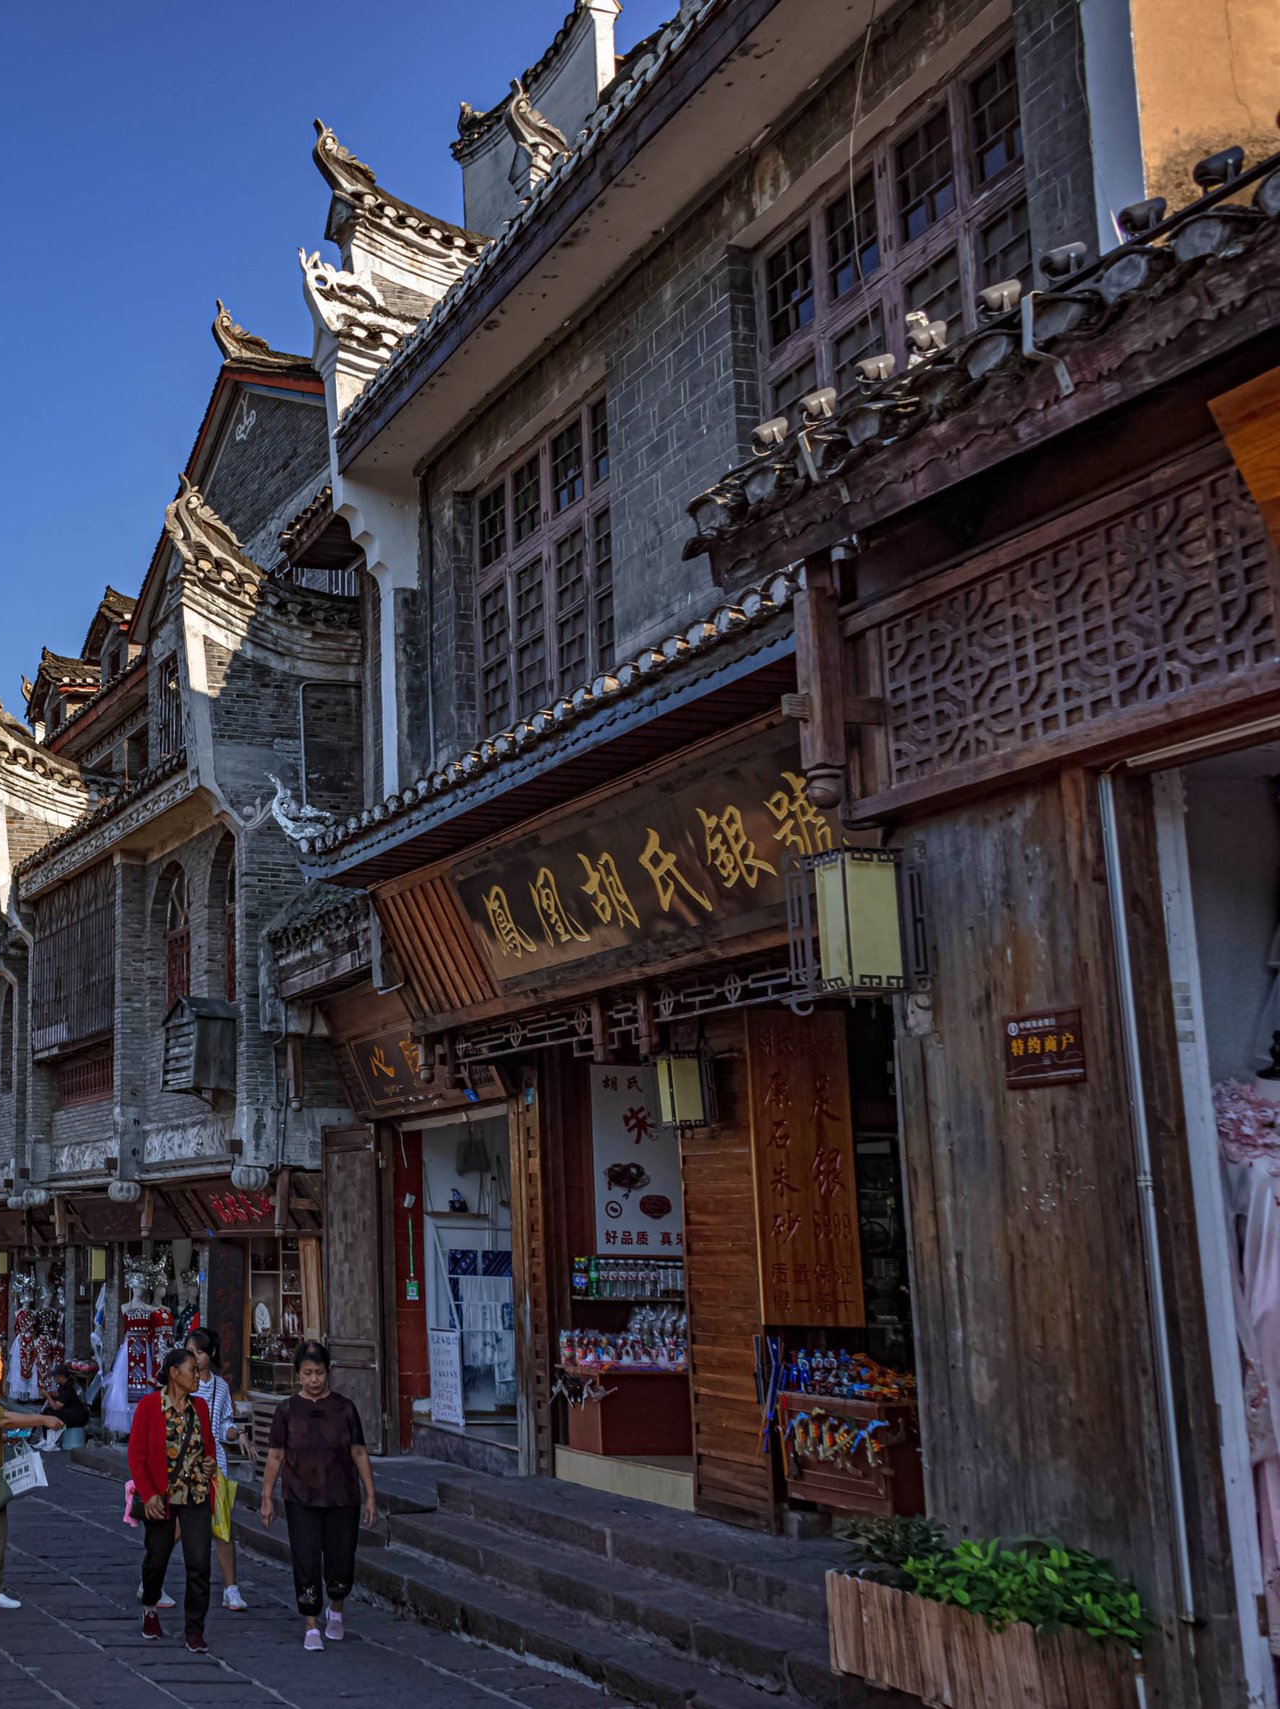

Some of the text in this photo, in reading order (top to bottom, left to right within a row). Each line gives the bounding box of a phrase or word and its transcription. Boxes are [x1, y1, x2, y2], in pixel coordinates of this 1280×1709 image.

[1011, 1032, 1074, 1056] 特约商户
[602, 1075, 643, 1093] 胡氏
[605, 1230, 649, 1245] 好品质
